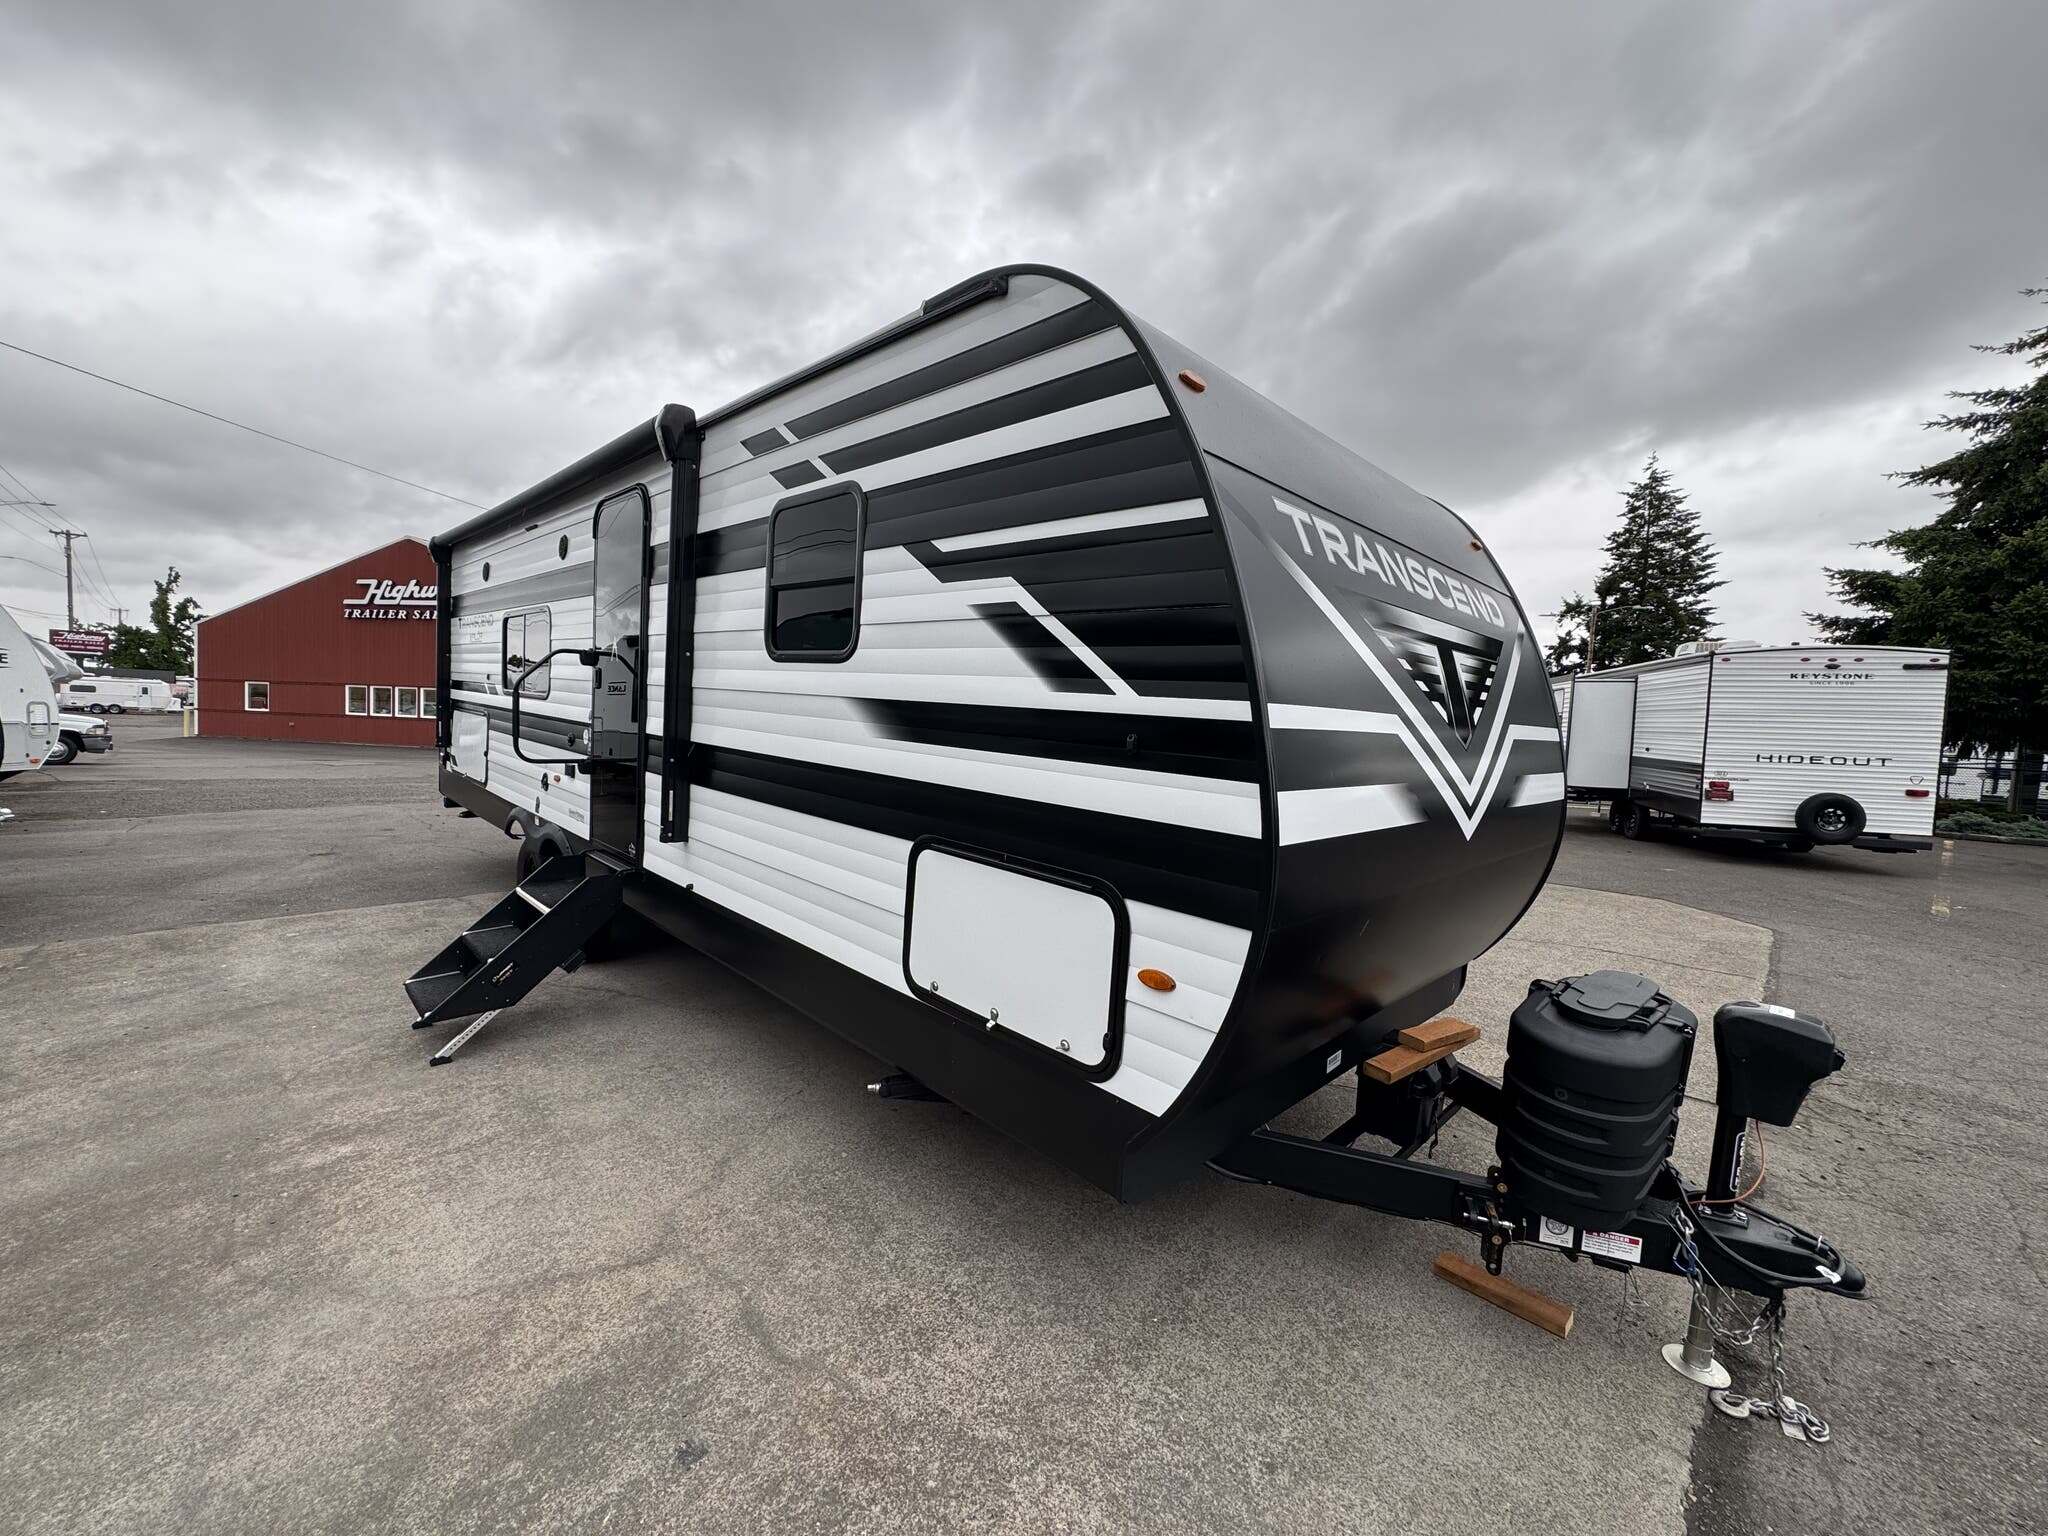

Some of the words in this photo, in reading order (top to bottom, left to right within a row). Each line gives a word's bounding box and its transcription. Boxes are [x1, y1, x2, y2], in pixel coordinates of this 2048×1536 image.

[1271, 495, 1505, 628] TRANSCEND
[343, 608, 407, 619] TRAILER
[1789, 672, 1875, 680] KEYSTONE
[1755, 753, 1893, 767] HIDEOUT
[1600, 1231, 1631, 1243] DANGER
